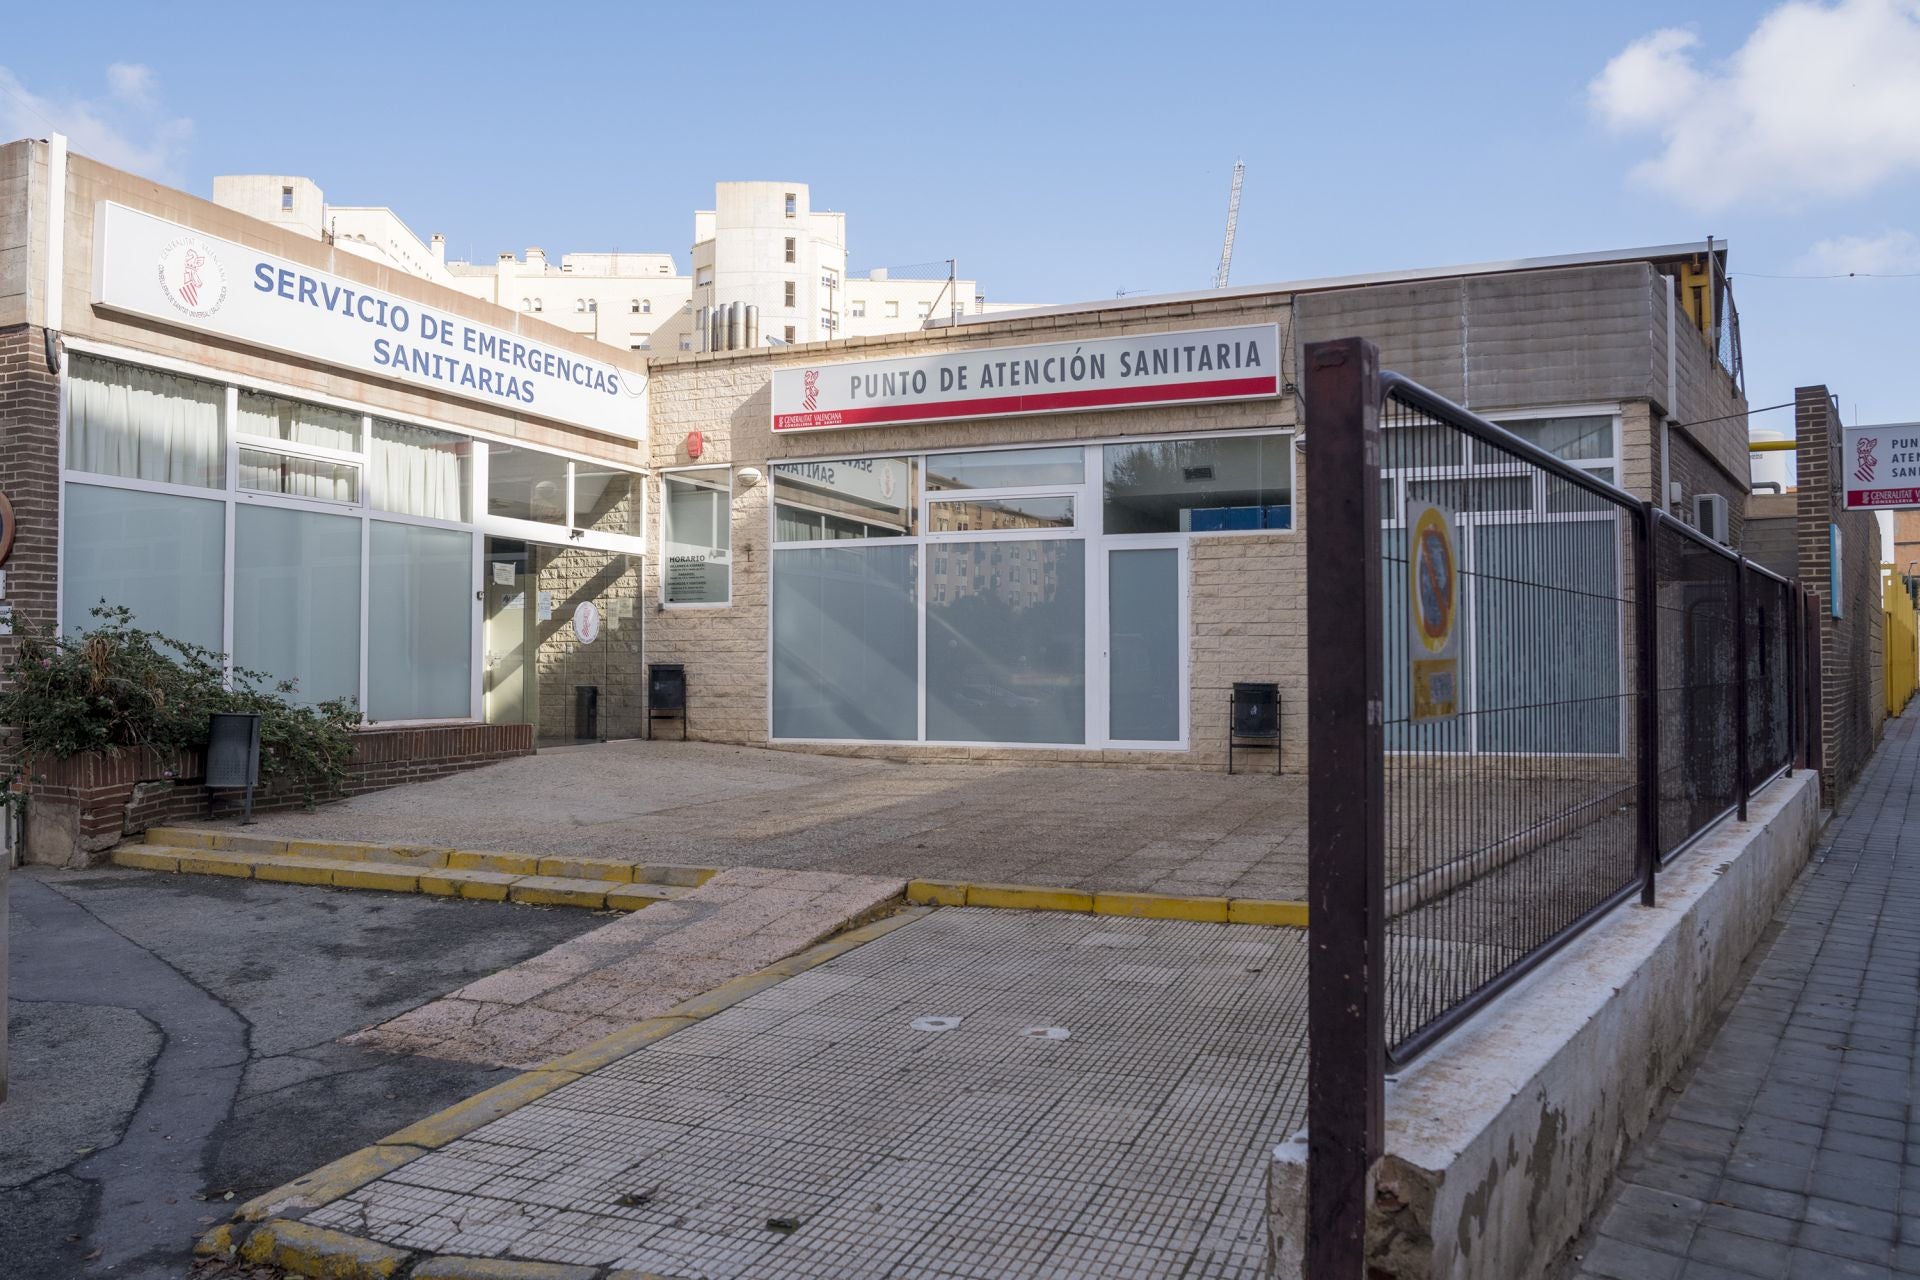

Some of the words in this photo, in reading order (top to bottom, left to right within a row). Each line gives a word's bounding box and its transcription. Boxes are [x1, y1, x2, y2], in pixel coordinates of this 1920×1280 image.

[254, 263, 409, 332] SERVICIO
[421, 314, 454, 346] DE
[464, 327, 619, 396] EMERGENCIAS
[374, 338, 535, 403] SANITARIAS
[850, 369, 928, 399] PUNTO
[940, 365, 968, 392] DE
[980, 347, 1106, 389] ATENCIÓN
[1120, 340, 1261, 378] SANITARIA
[784, 415, 812, 424] GENERALITAT
[814, 413, 842, 422] VALENCIANA
[1870, 490, 1912, 500] GENERALITAT
